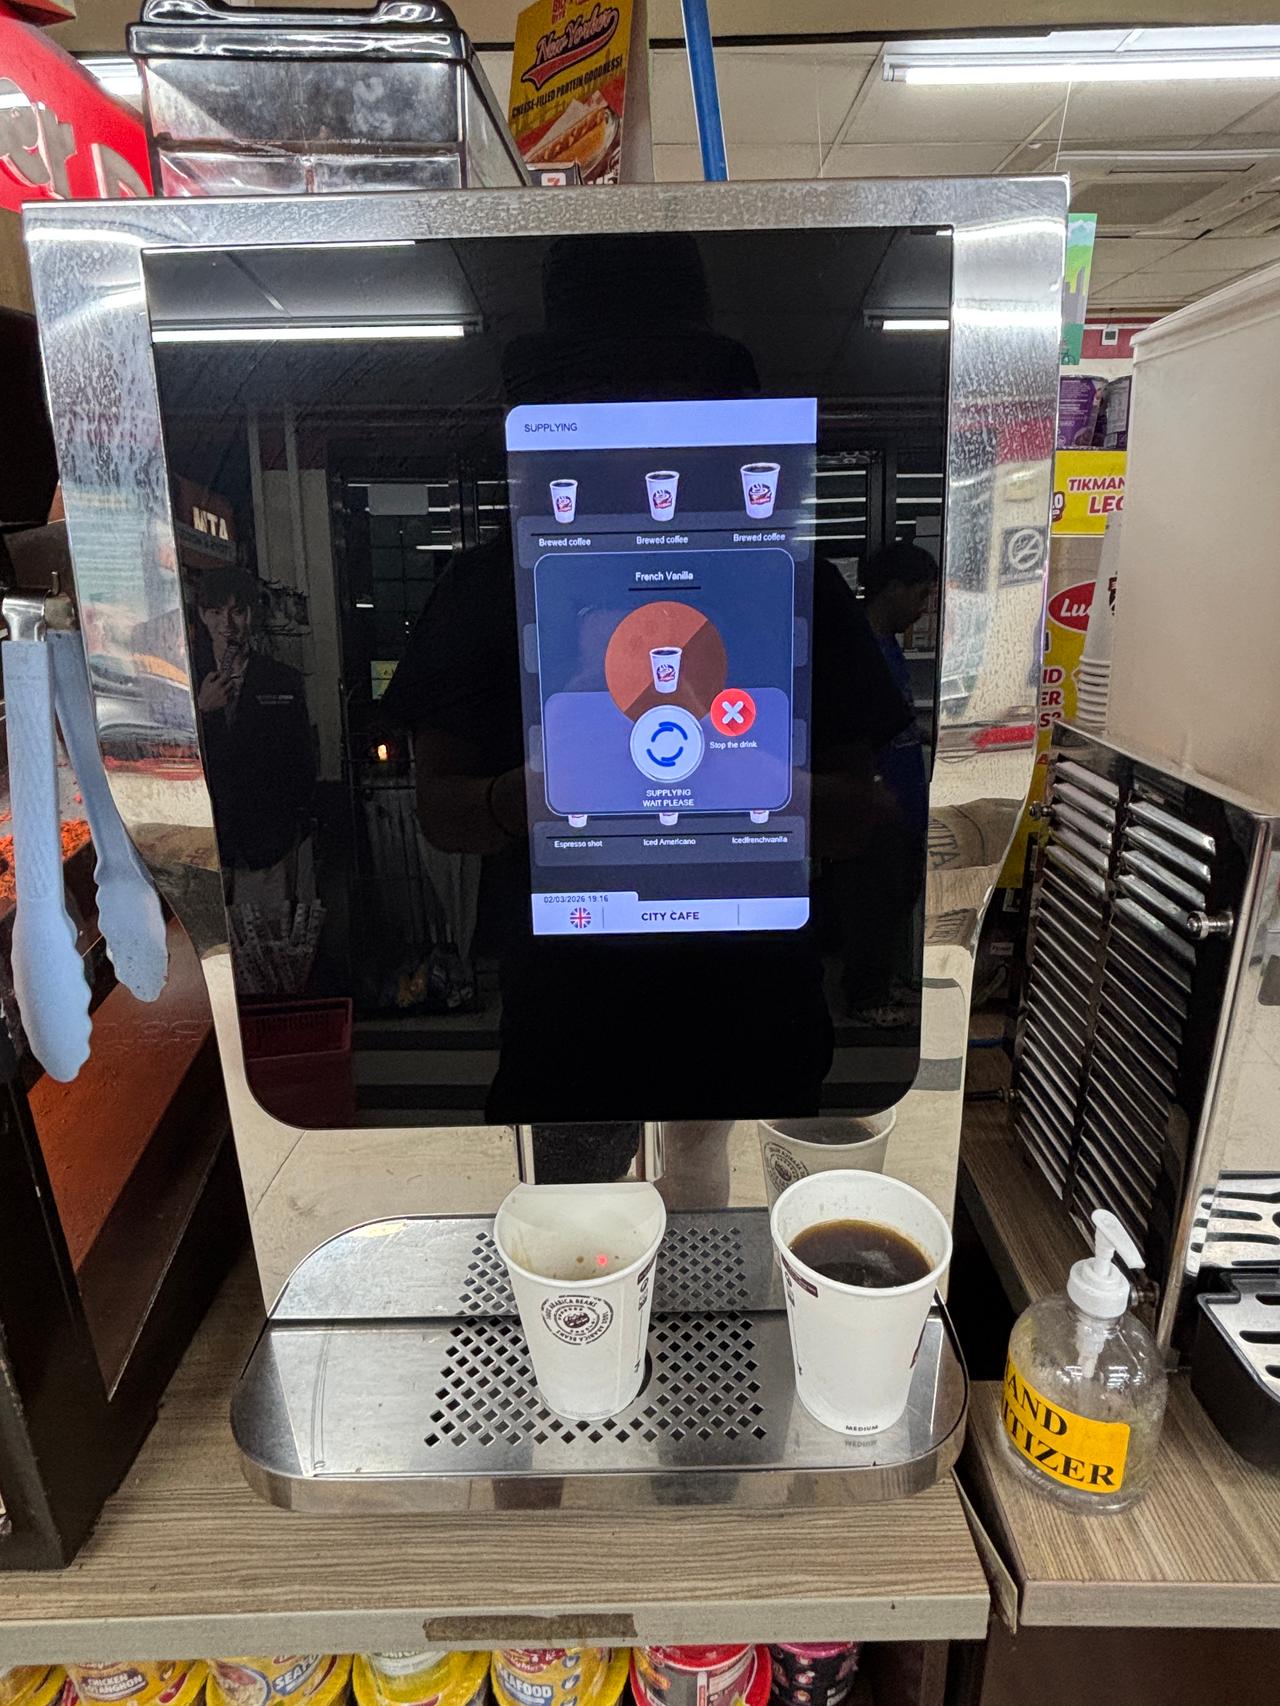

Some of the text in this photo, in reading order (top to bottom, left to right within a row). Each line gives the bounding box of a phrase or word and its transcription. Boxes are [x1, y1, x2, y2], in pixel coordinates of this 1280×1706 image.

[524, 422, 577, 433] SUPPLYING
[539, 537, 591, 547] Brewed coffee
[636, 535, 689, 545] Brewed coffee
[733, 533, 786, 542] Brewed coffee
[635, 570, 694, 582] French Vanilla
[710, 740, 757, 750] Stop the drink
[646, 788, 691, 797] SUPPLYING
[643, 798, 695, 807] WAIT PLEASE
[554, 840, 587, 849] Espresso
[643, 837, 696, 846] Iced Americano
[543, 895, 586, 904] 02/03/2026
[641, 911, 700, 921] CITY CAFE
[1006, 1370, 1068, 1436] AND
[845, 1424, 879, 1432] MEDIUM
